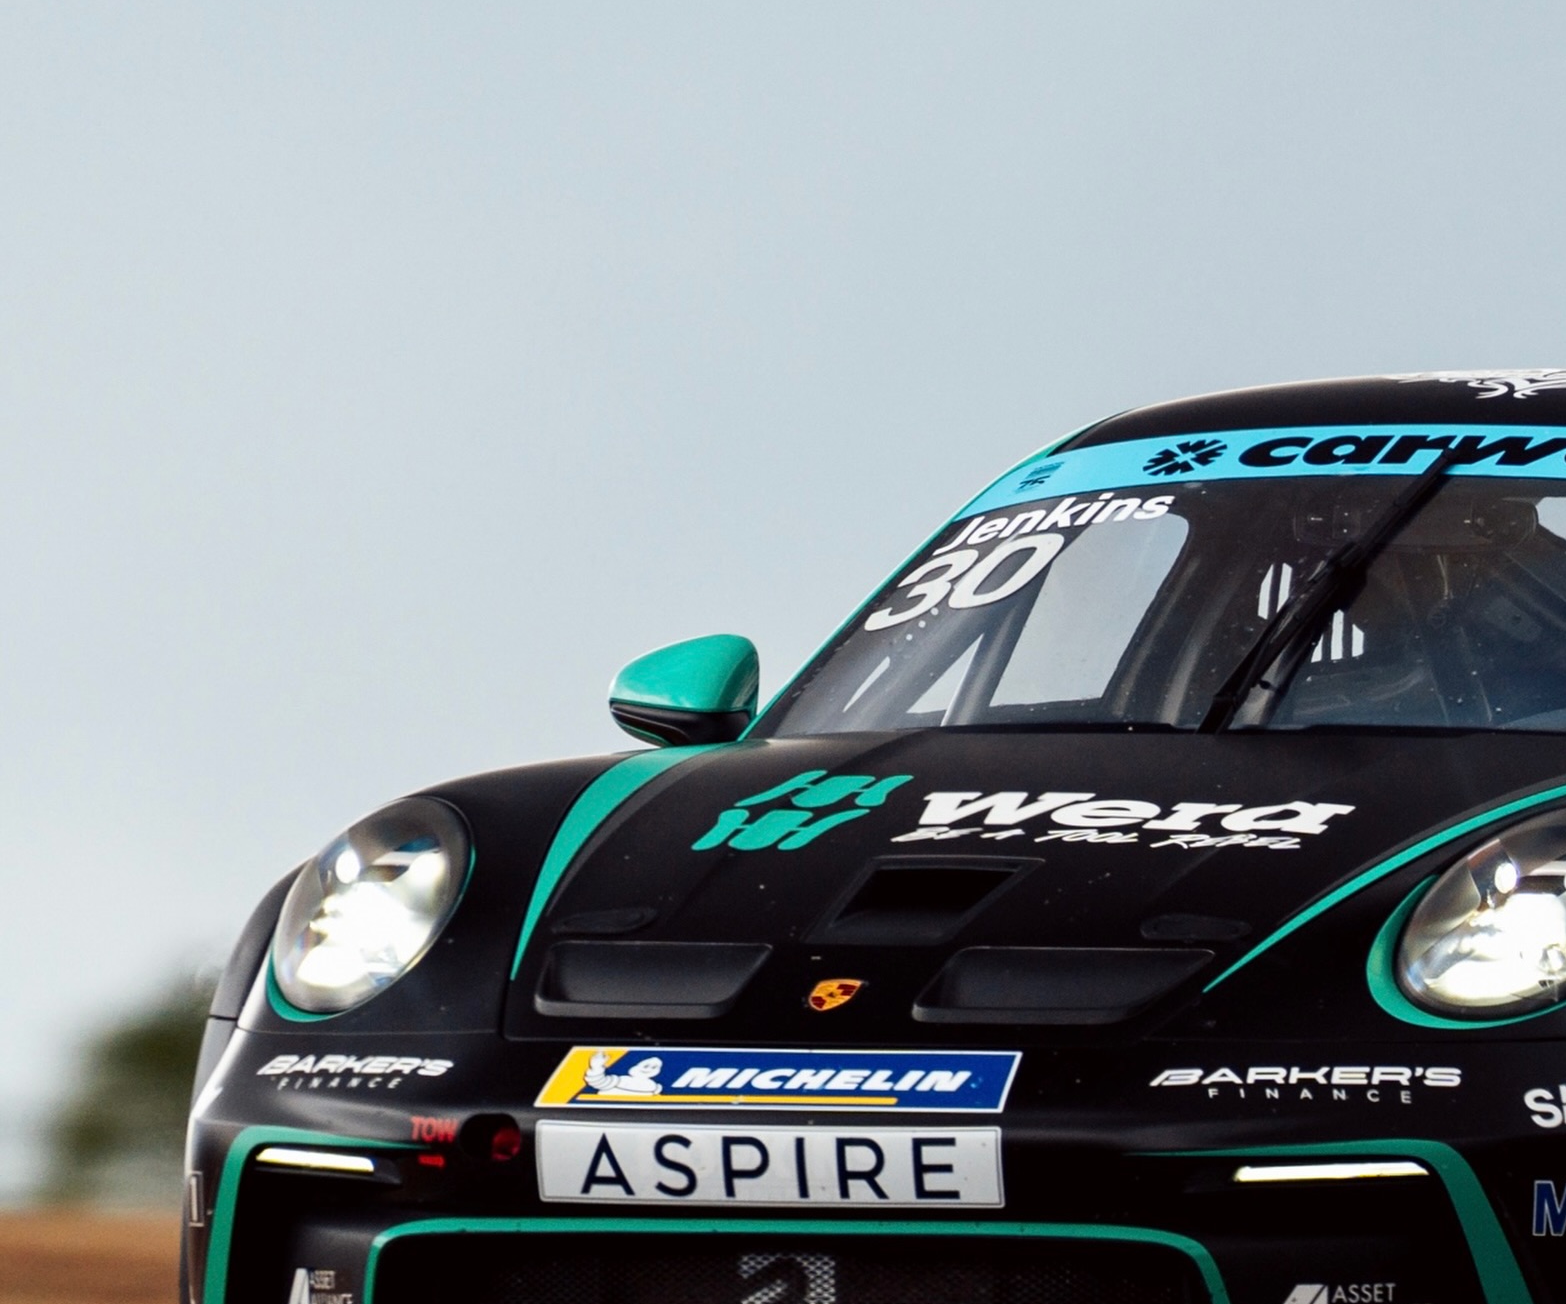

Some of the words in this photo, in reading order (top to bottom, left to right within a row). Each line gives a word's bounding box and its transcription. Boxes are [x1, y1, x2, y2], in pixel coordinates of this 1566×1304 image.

[934, 493, 1175, 555] Jenkins
[864, 533, 1065, 631] 30
[918, 791, 1357, 834] Wera
[256, 1054, 454, 1076] BARKER'S
[1149, 1066, 1462, 1088] BARKER'S
[277, 1077, 402, 1091] FINANCE
[671, 1067, 972, 1092] MICHELIN
[1207, 1088, 1413, 1105] FINANCE
[411, 1115, 459, 1142] TOW
[580, 1133, 961, 1201] ASPIRE
[1332, 1283, 1396, 1303] ASSET
